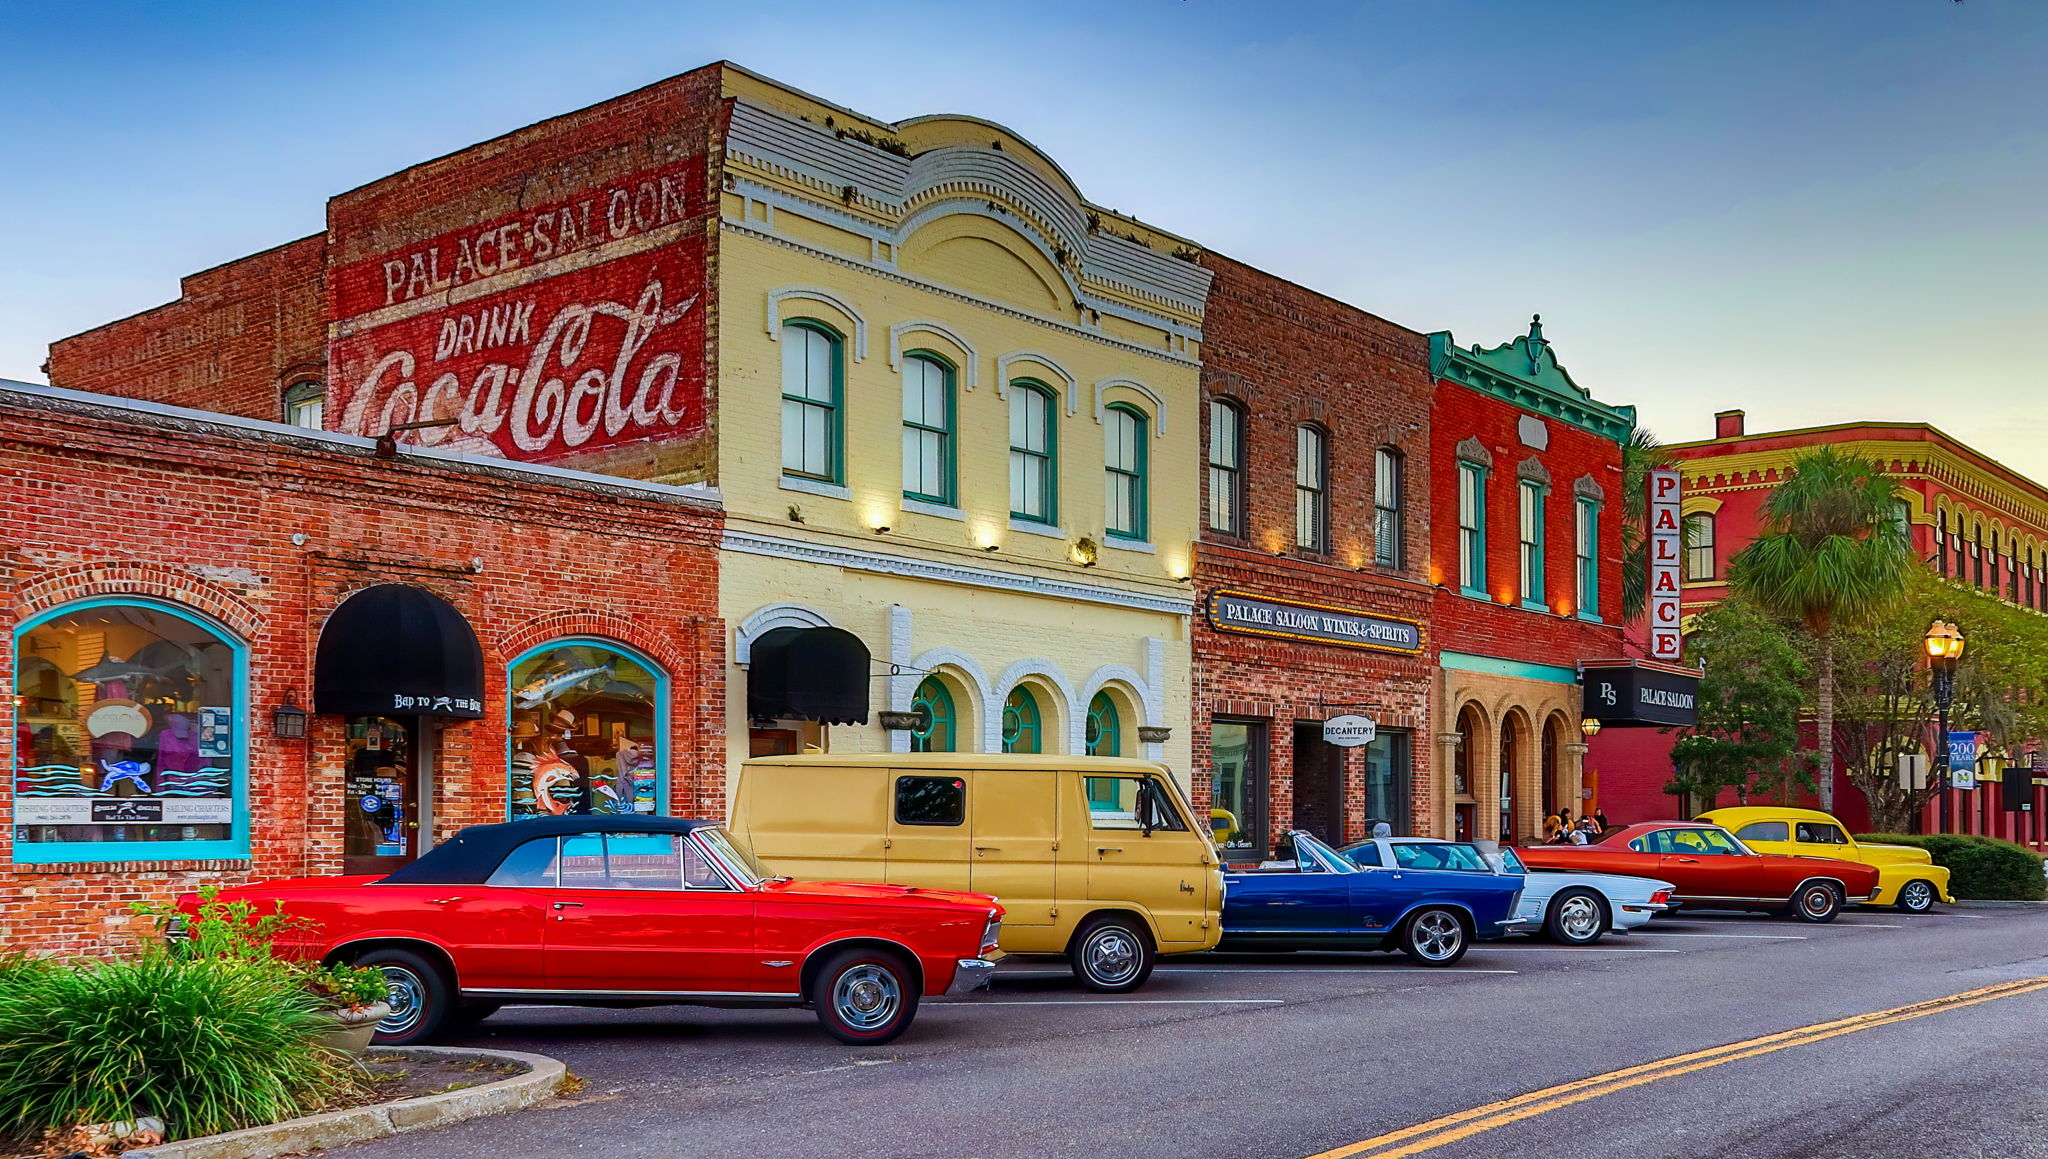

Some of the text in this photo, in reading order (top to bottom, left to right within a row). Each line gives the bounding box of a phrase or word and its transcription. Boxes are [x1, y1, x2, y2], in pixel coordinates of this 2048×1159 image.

[383, 175, 689, 302] PALACE SALOON
[435, 300, 536, 362] DRINK
[340, 277, 699, 452] Coca-Cola
[1655, 477, 1678, 655] PALACE
[1226, 603, 1273, 625] PALACE
[1276, 610, 1319, 631] SALOON
[1370, 624, 1410, 643] SPIRITS
[1640, 687, 1694, 710] PALACE SALOON
[1325, 727, 1374, 735] DECANTERY
[1950, 742, 1975, 755] 200
